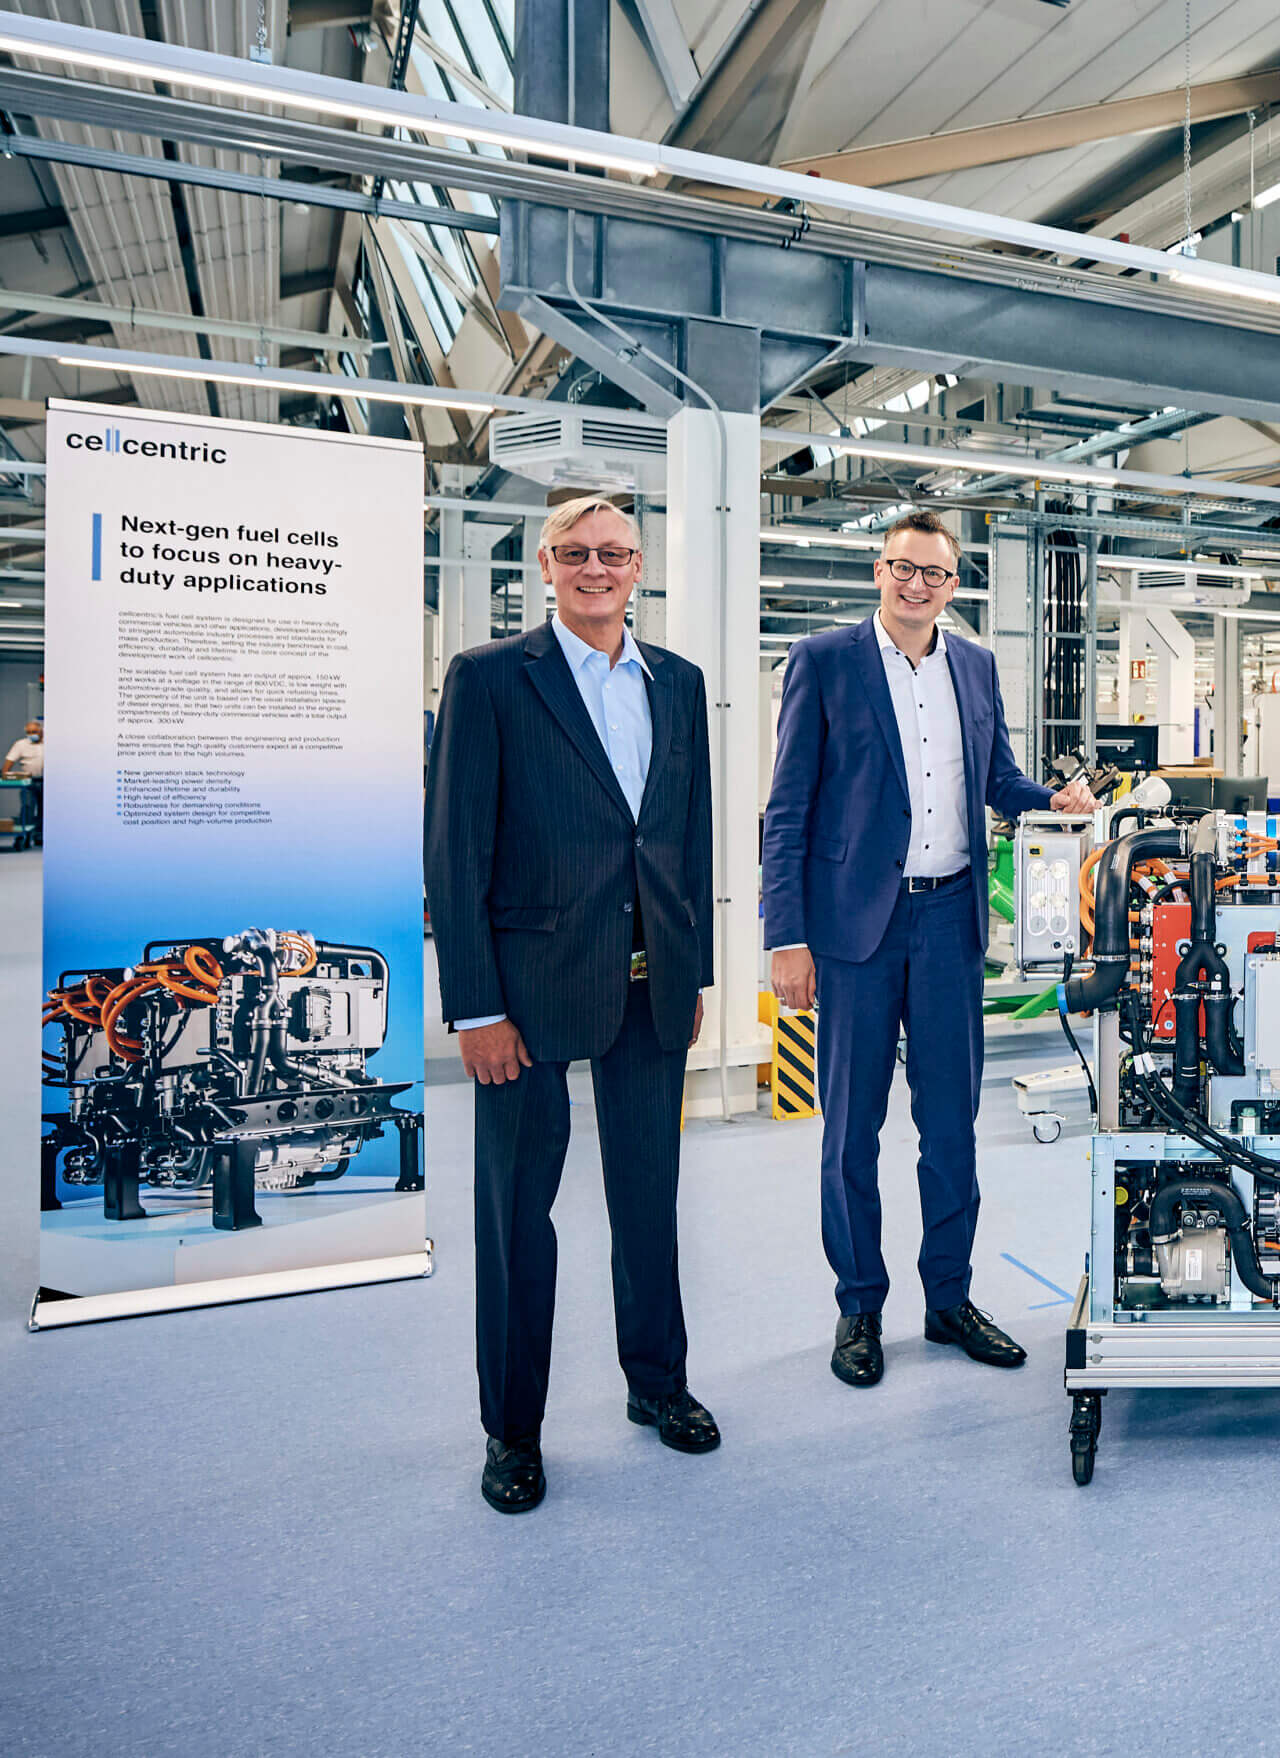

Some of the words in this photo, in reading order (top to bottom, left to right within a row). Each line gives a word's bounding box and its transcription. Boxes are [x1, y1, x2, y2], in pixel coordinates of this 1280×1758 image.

[66, 428, 227, 464] cellcentric
[122, 516, 228, 541] Next-gen
[237, 526, 278, 543] fuel
[288, 531, 338, 547] cells
[120, 542, 144, 558] to
[152, 544, 220, 564] focus
[229, 554, 257, 566] on
[268, 552, 342, 575] heavy-
[120, 568, 174, 590] duty
[184, 574, 326, 595] applications
